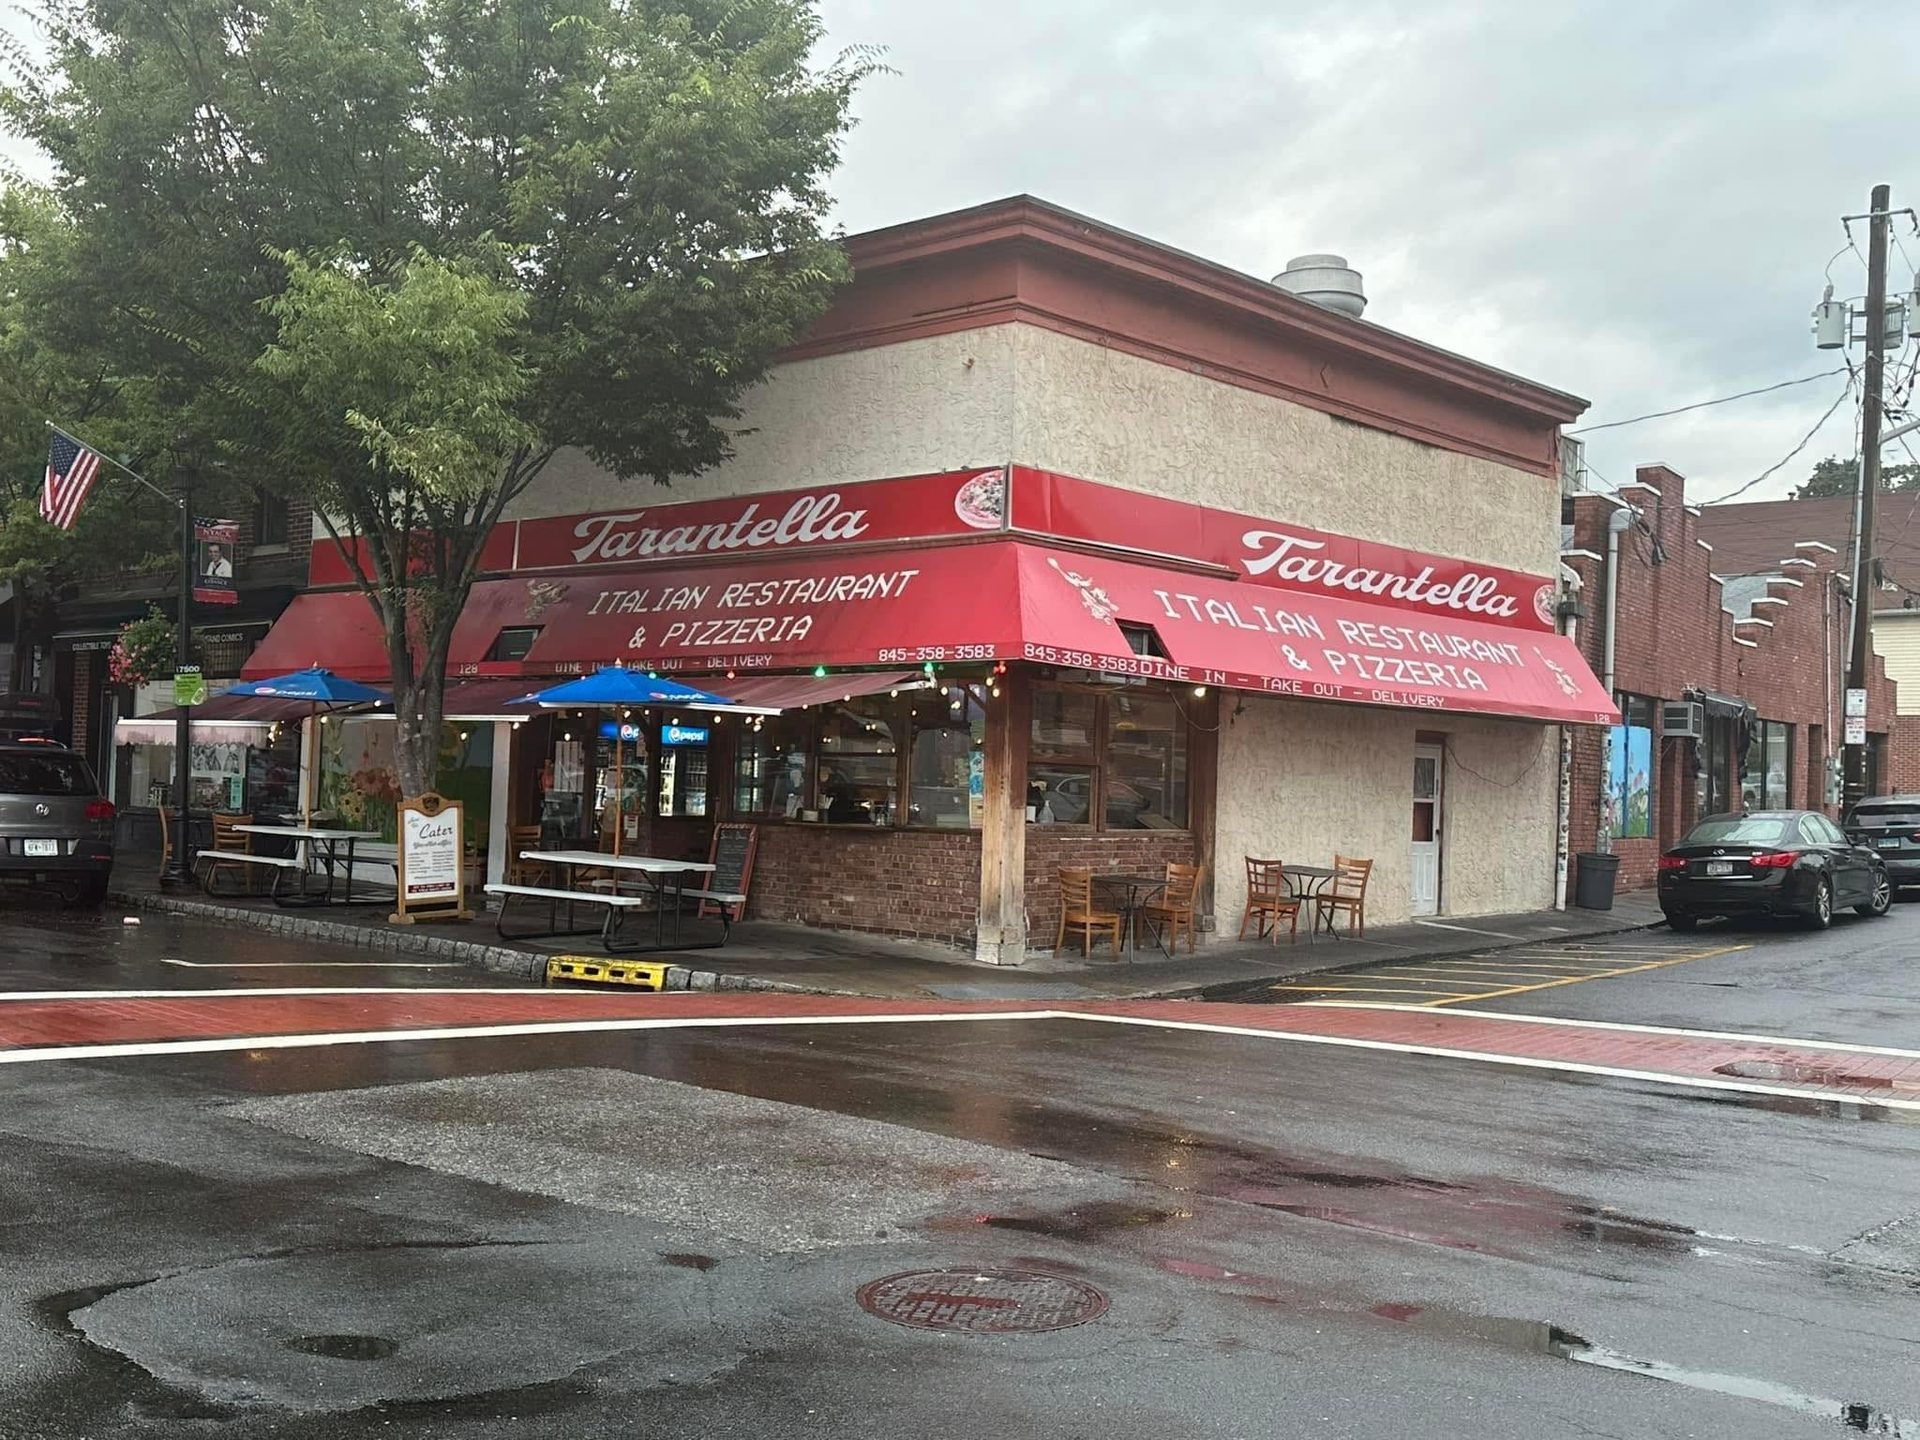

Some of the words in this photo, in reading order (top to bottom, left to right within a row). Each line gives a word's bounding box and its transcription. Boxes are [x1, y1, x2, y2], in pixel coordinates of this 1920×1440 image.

[571, 493, 869, 563] Tarantella
[1240, 530, 1518, 617] Tarantella
[587, 585, 711, 615] ITALIAN
[717, 570, 920, 609] RESTAURANT
[628, 626, 646, 649] &
[660, 615, 813, 647] PIZZERIA
[1153, 590, 1325, 641] ITALIAN
[1337, 619, 1525, 667] RESTAURANT
[459, 664, 478, 674] 128
[555, 662, 583, 673] DINE
[662, 659, 684, 669] OUT
[707, 654, 773, 668] DELIVERY
[879, 645, 995, 661] 845-358-3583
[1024, 643, 1137, 672] 845-358-3583
[1281, 644, 1312, 672] &
[1322, 649, 1488, 691] PIZZERIA
[1140, 662, 1190, 679] DINE
[1204, 669, 1226, 684] IN
[1261, 676, 1303, 693] TAKE
[1313, 683, 1342, 697] OUT
[1372, 690, 1445, 707] DELIVERY
[680, 731, 704, 742] pepsi
[419, 823, 453, 839] Cater
